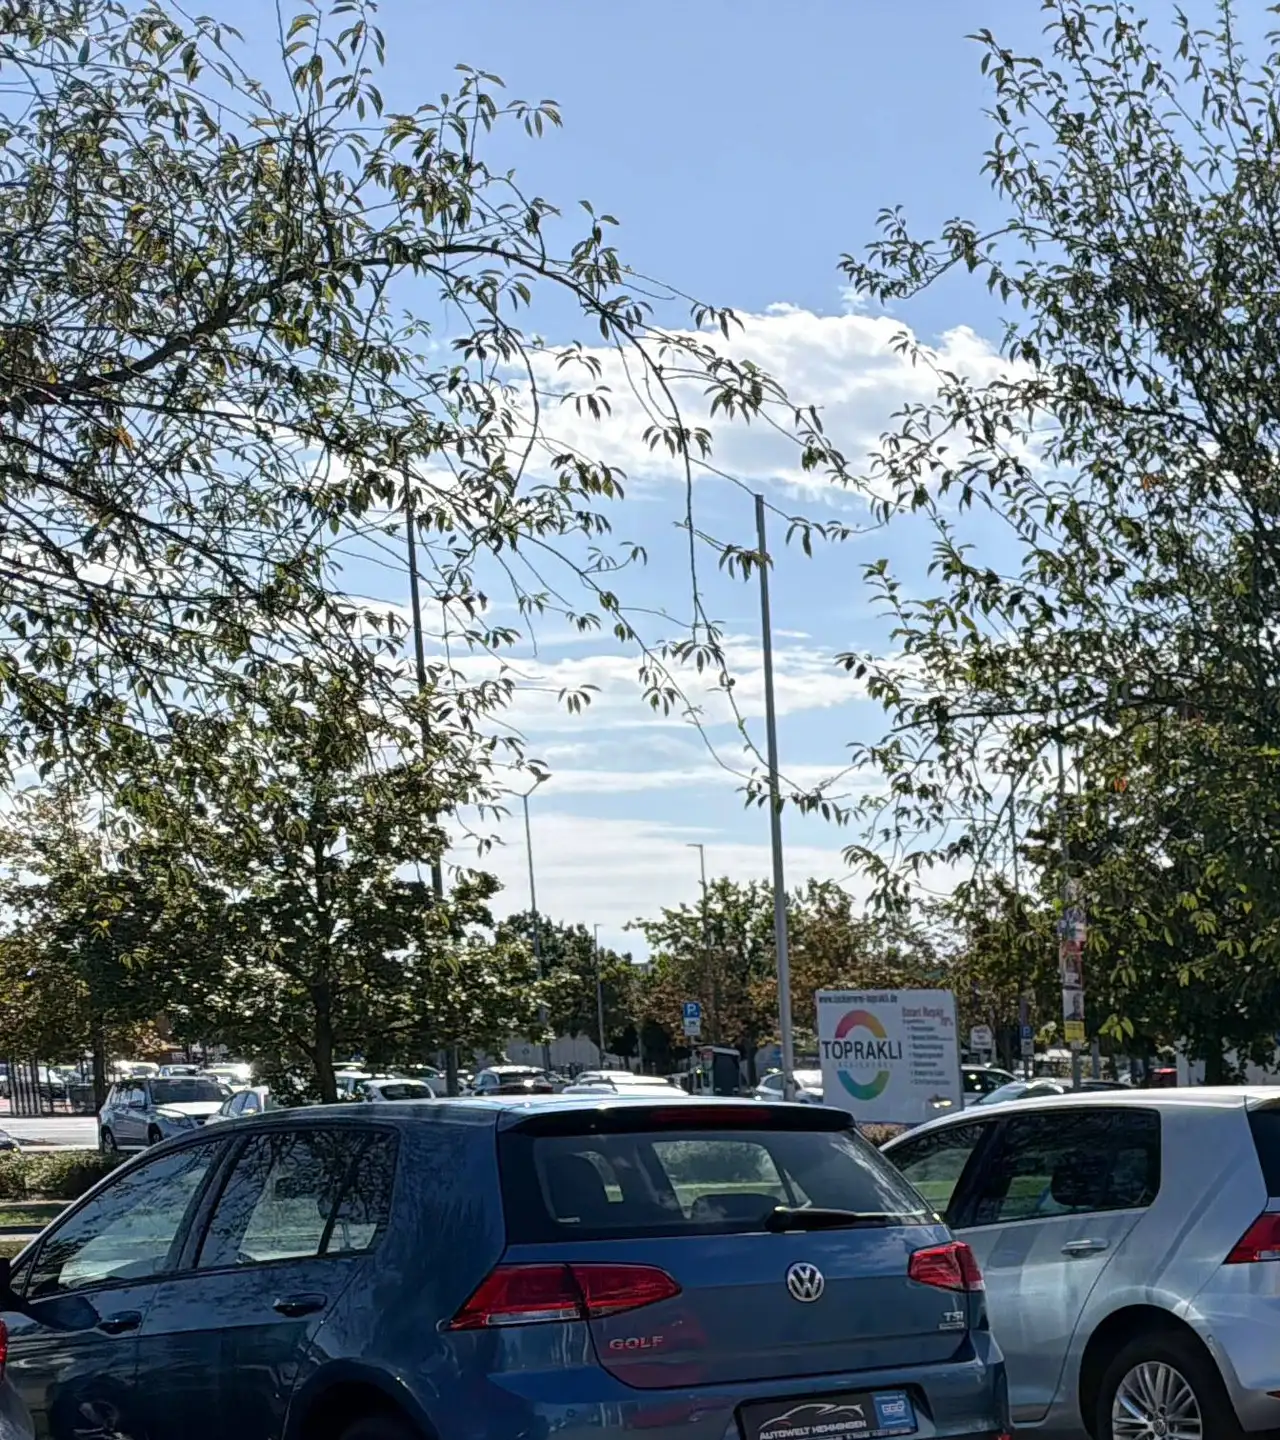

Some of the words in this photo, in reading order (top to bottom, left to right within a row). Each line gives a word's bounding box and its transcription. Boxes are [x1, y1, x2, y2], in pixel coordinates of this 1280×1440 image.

[821, 1040, 902, 1060] TOPRAKLI
[609, 1336, 663, 1350] GOLF
[759, 1427, 810, 1440] AUTOWELT
